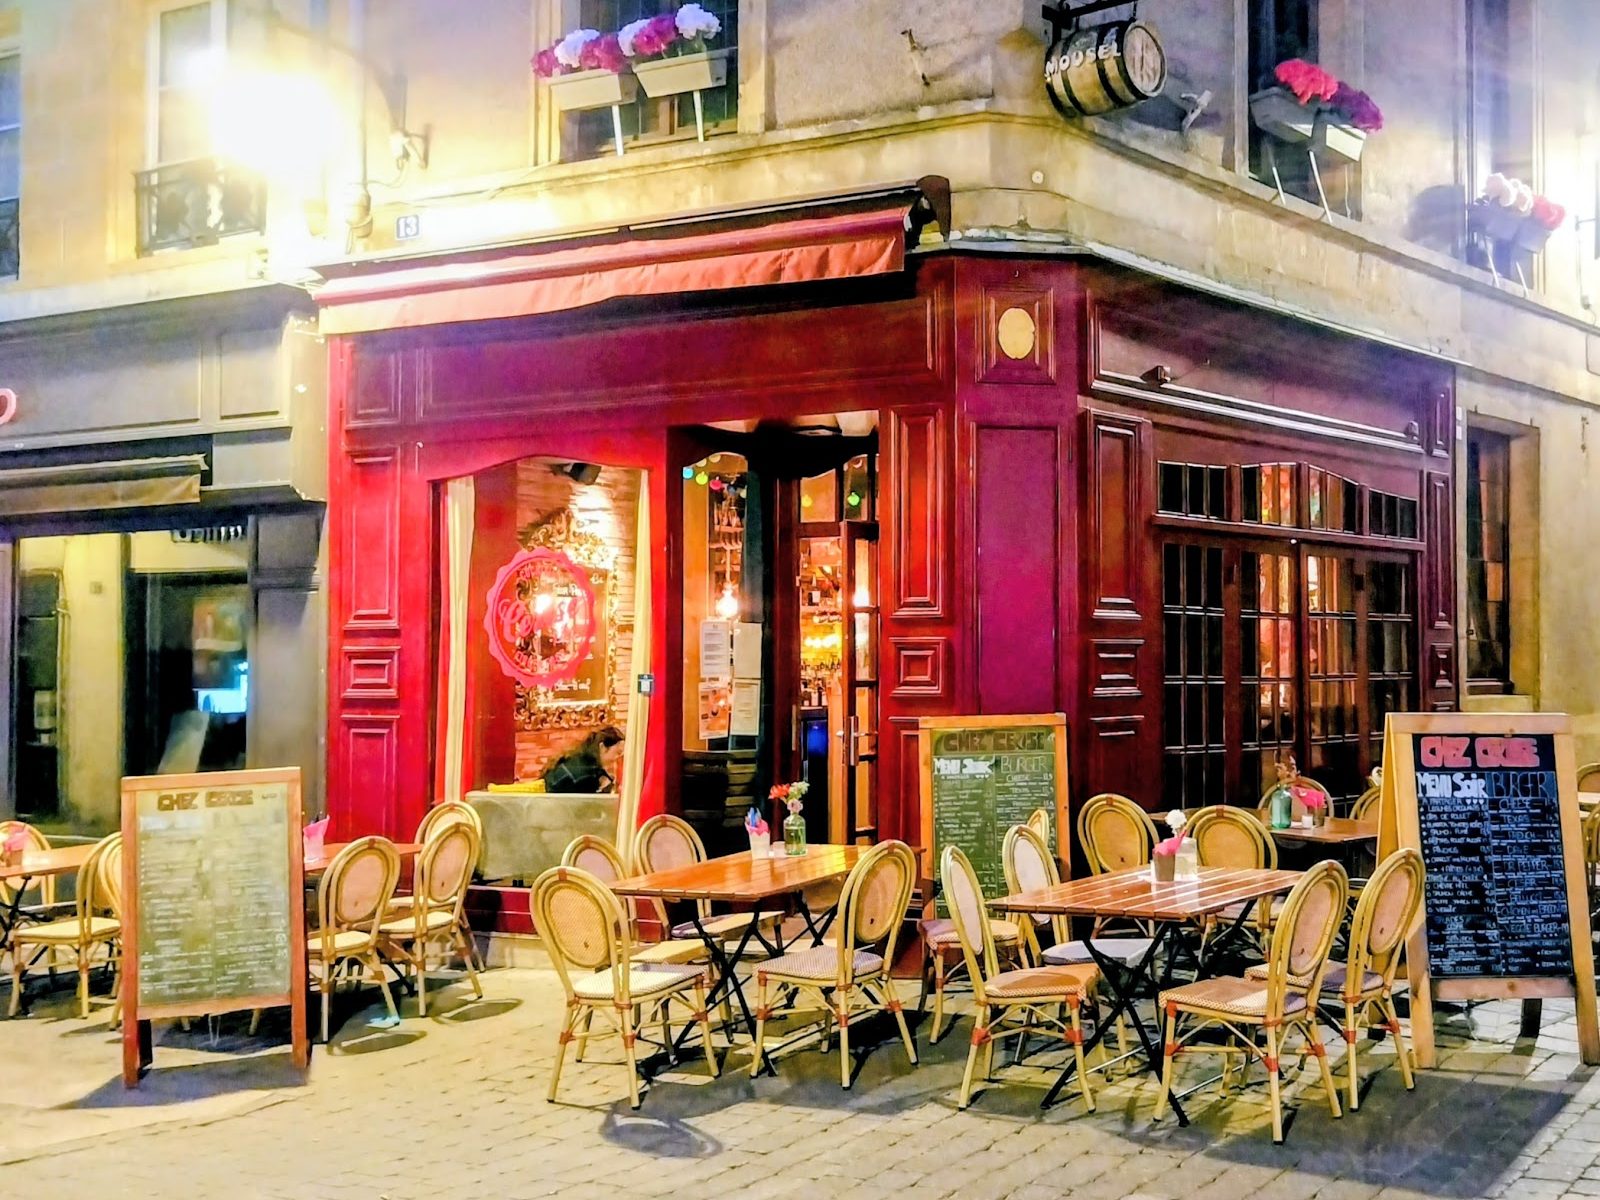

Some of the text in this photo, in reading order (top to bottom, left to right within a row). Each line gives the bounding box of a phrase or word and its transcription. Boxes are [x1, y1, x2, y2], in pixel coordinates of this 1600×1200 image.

[399, 216, 417, 237] 13
[943, 732, 986, 752] CHEZ
[1001, 755, 1048, 774] BURGER
[1492, 771, 1550, 798] BURGER
